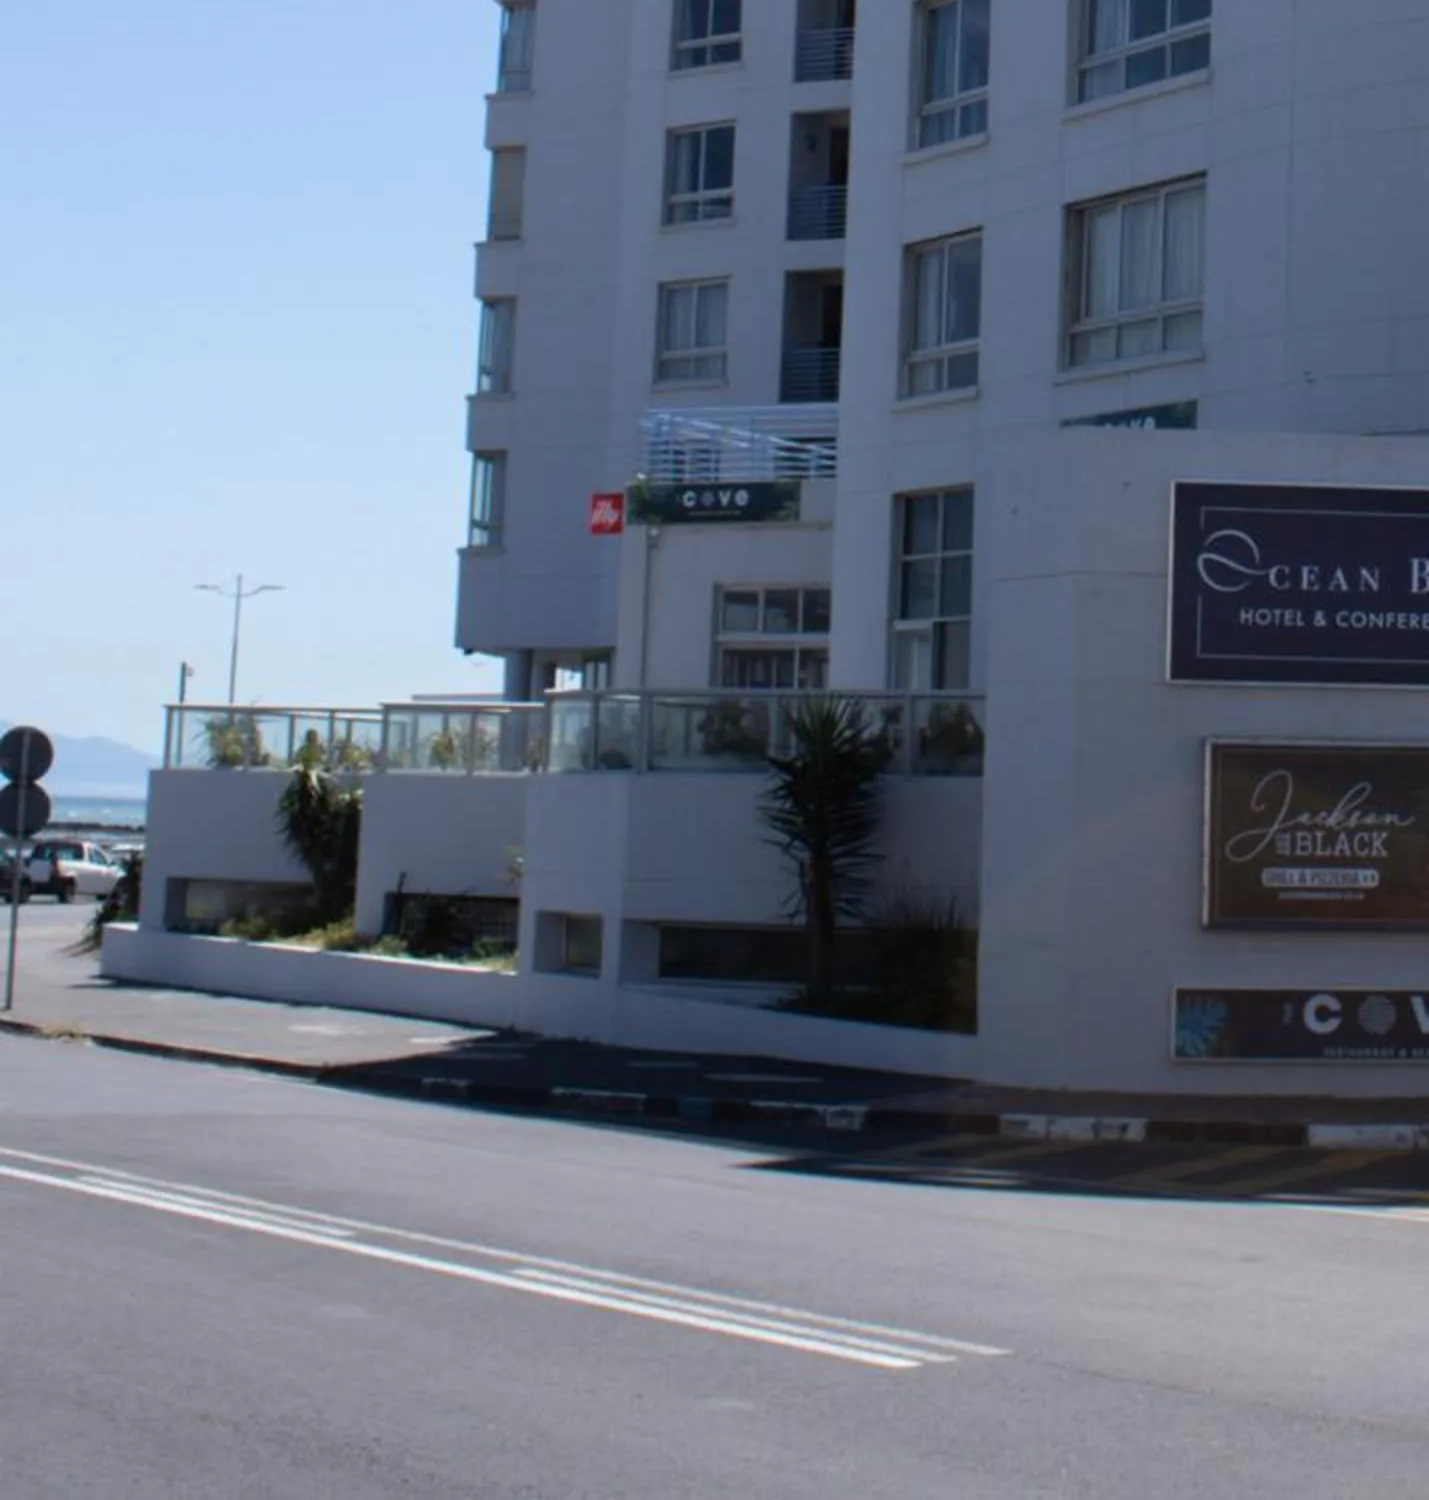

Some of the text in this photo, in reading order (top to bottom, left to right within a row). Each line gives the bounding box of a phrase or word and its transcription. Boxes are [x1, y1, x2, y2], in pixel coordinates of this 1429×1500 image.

[1239, 607, 1305, 627] HOTEL
[1312, 610, 1328, 628] &
[1225, 769, 1416, 863] Jackson
[1292, 831, 1389, 858] BLACK
